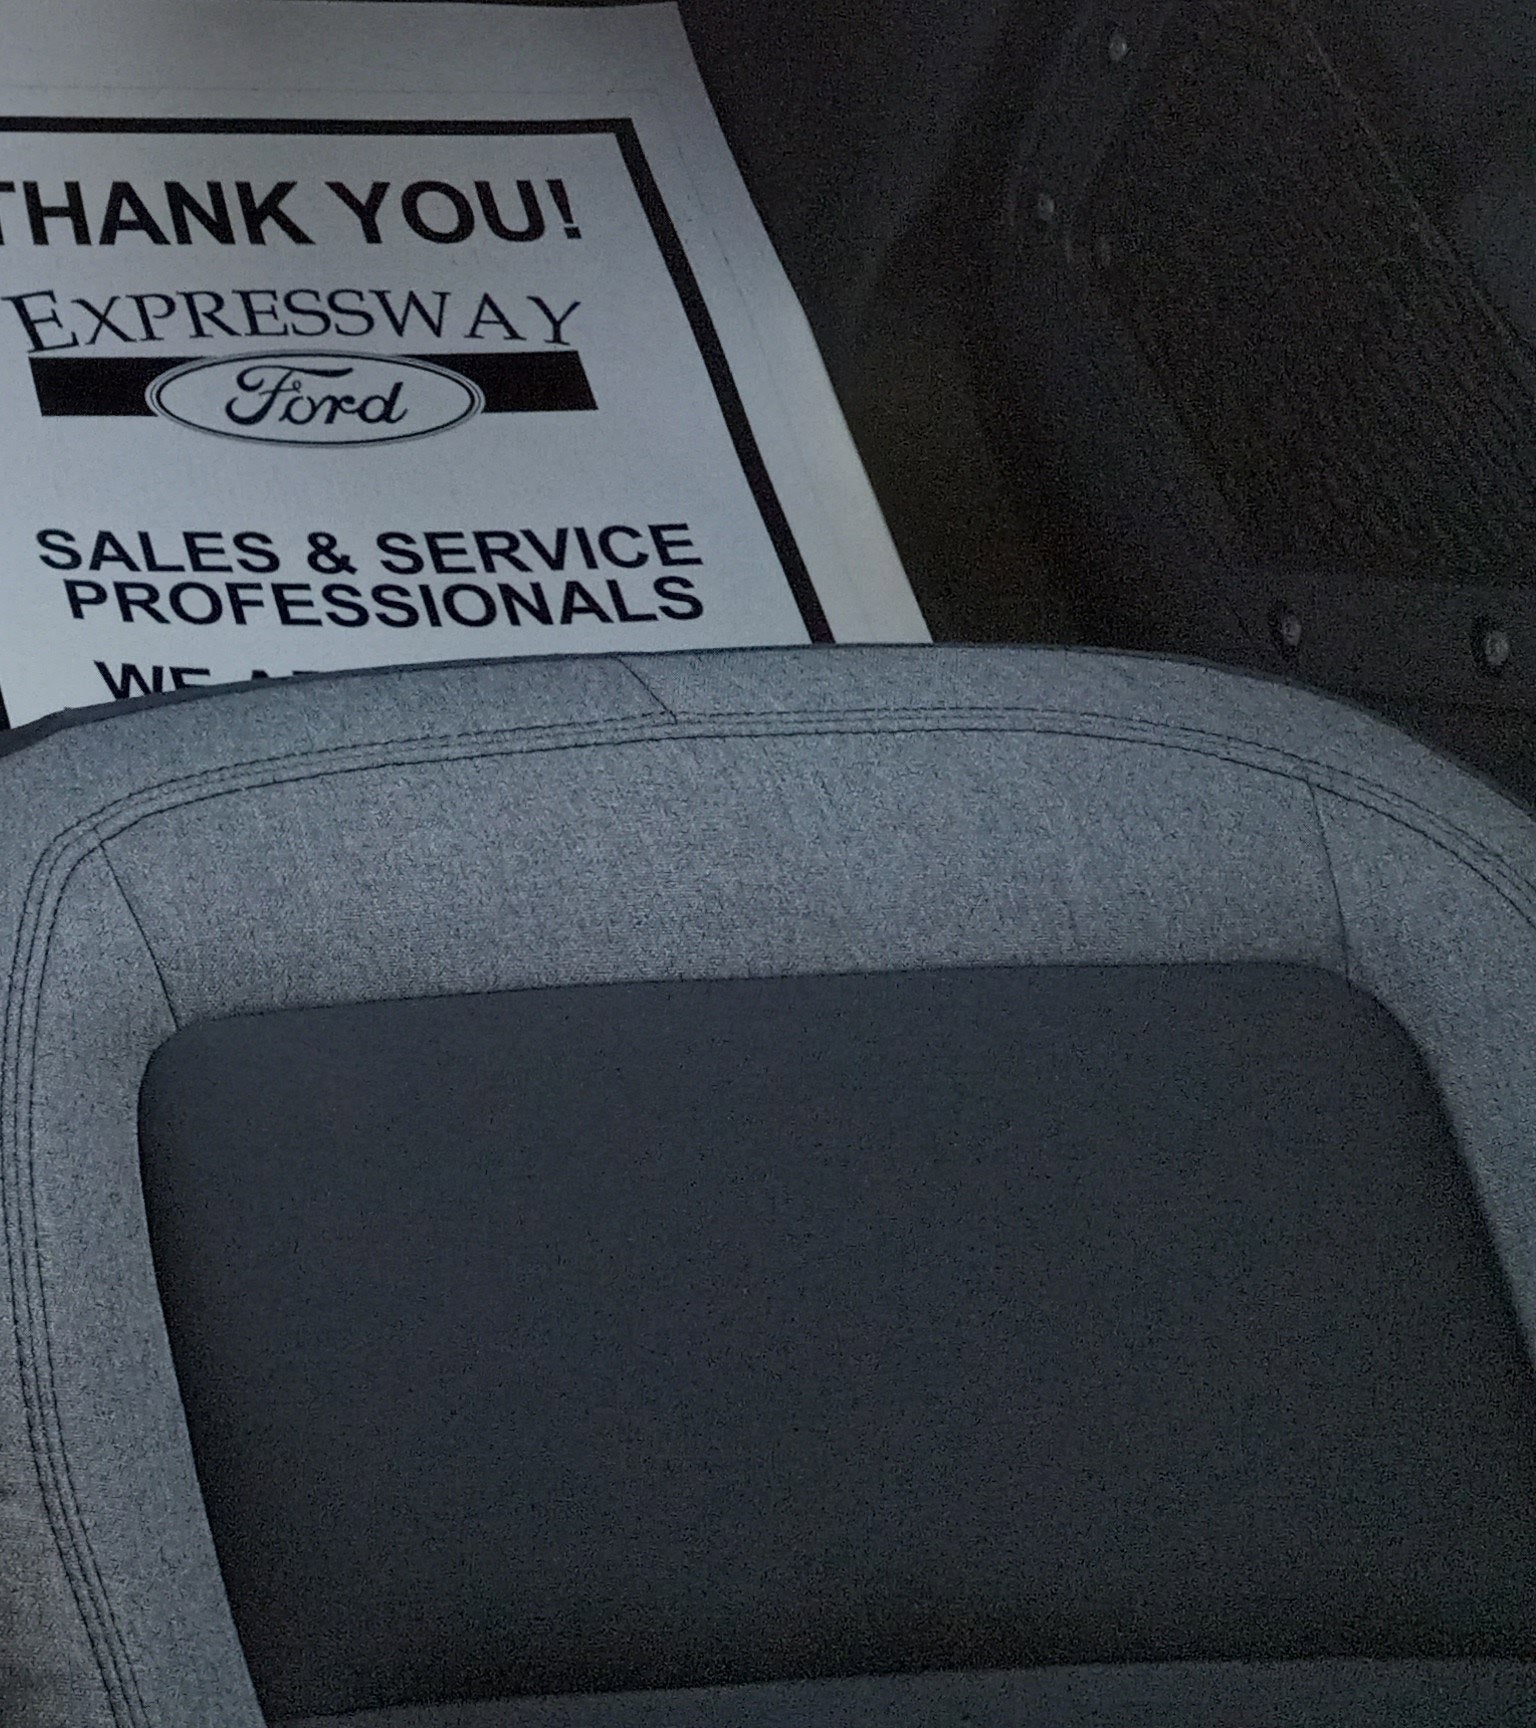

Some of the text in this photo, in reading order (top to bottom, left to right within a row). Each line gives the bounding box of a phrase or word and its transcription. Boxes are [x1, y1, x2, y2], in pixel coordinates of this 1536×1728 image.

[326, 178, 582, 246] YOU!
[1, 288, 580, 354] EXPRESSWAY
[224, 361, 409, 428] Ford
[34, 522, 703, 576] SALES & SERVICE
[63, 575, 704, 629] PROFESSIONALS
